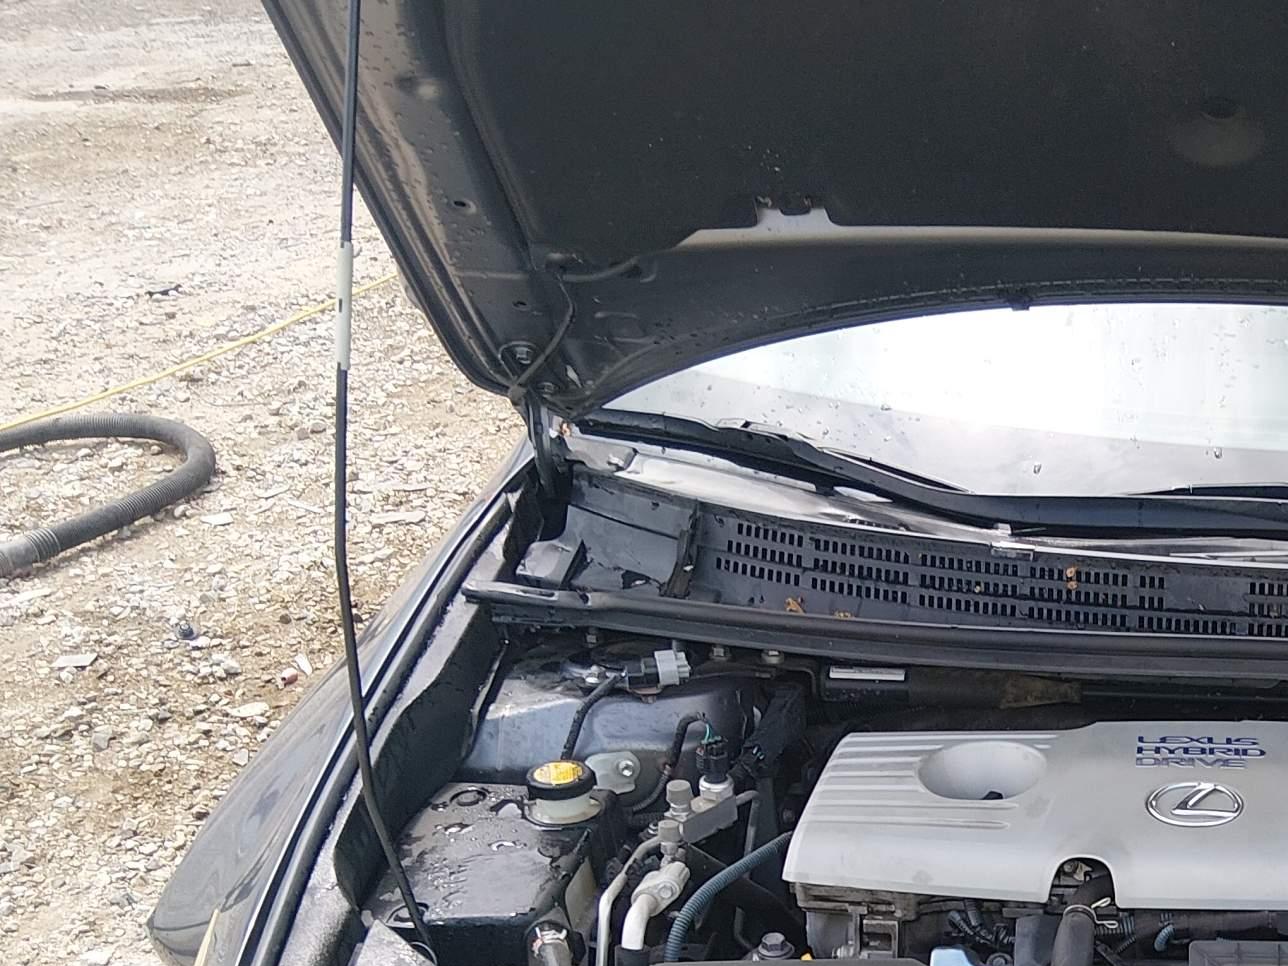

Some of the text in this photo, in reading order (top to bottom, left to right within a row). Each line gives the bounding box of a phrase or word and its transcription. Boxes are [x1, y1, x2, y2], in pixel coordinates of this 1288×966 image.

[1137, 735, 1260, 746] LEXUS
[1136, 746, 1267, 758] HYBRID
[1135, 757, 1248, 769] DRIVE
